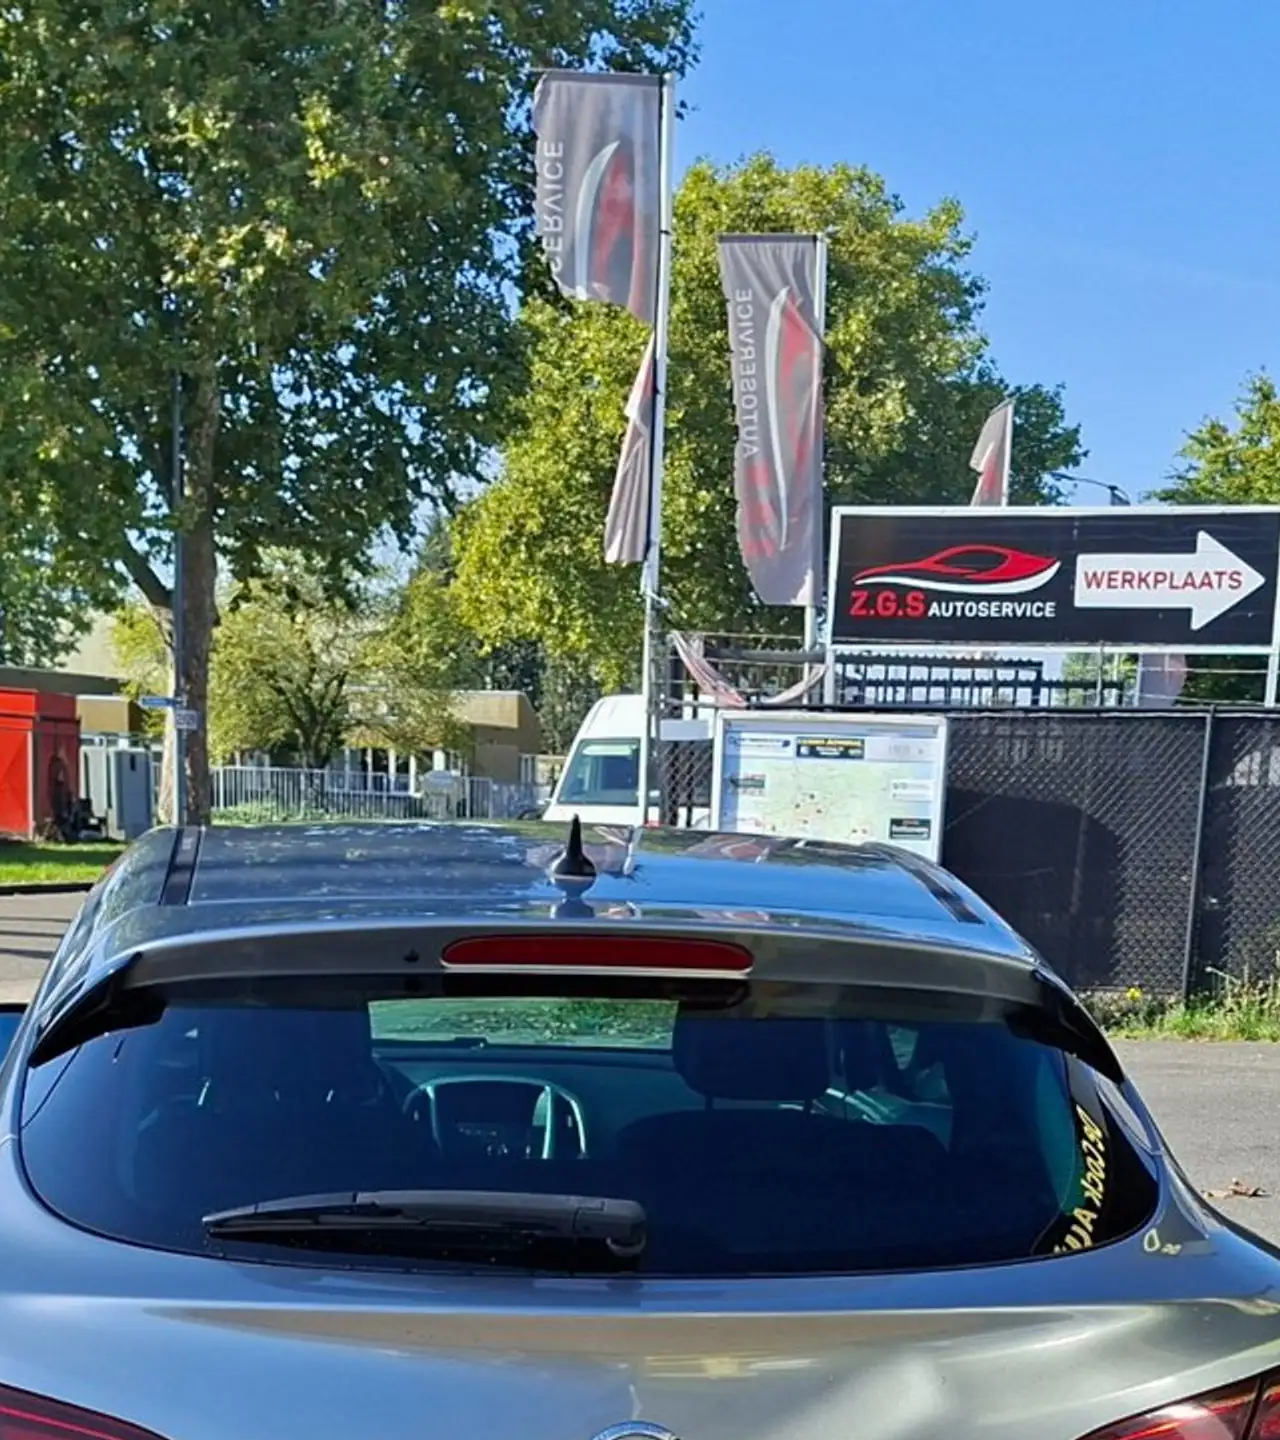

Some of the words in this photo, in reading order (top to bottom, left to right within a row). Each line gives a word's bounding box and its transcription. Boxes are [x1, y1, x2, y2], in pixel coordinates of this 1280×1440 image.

[1083, 569, 1243, 591] WERKPLAATS
[850, 590, 926, 618] Z.G.S
[928, 601, 1056, 618] AUTOSERVICE
